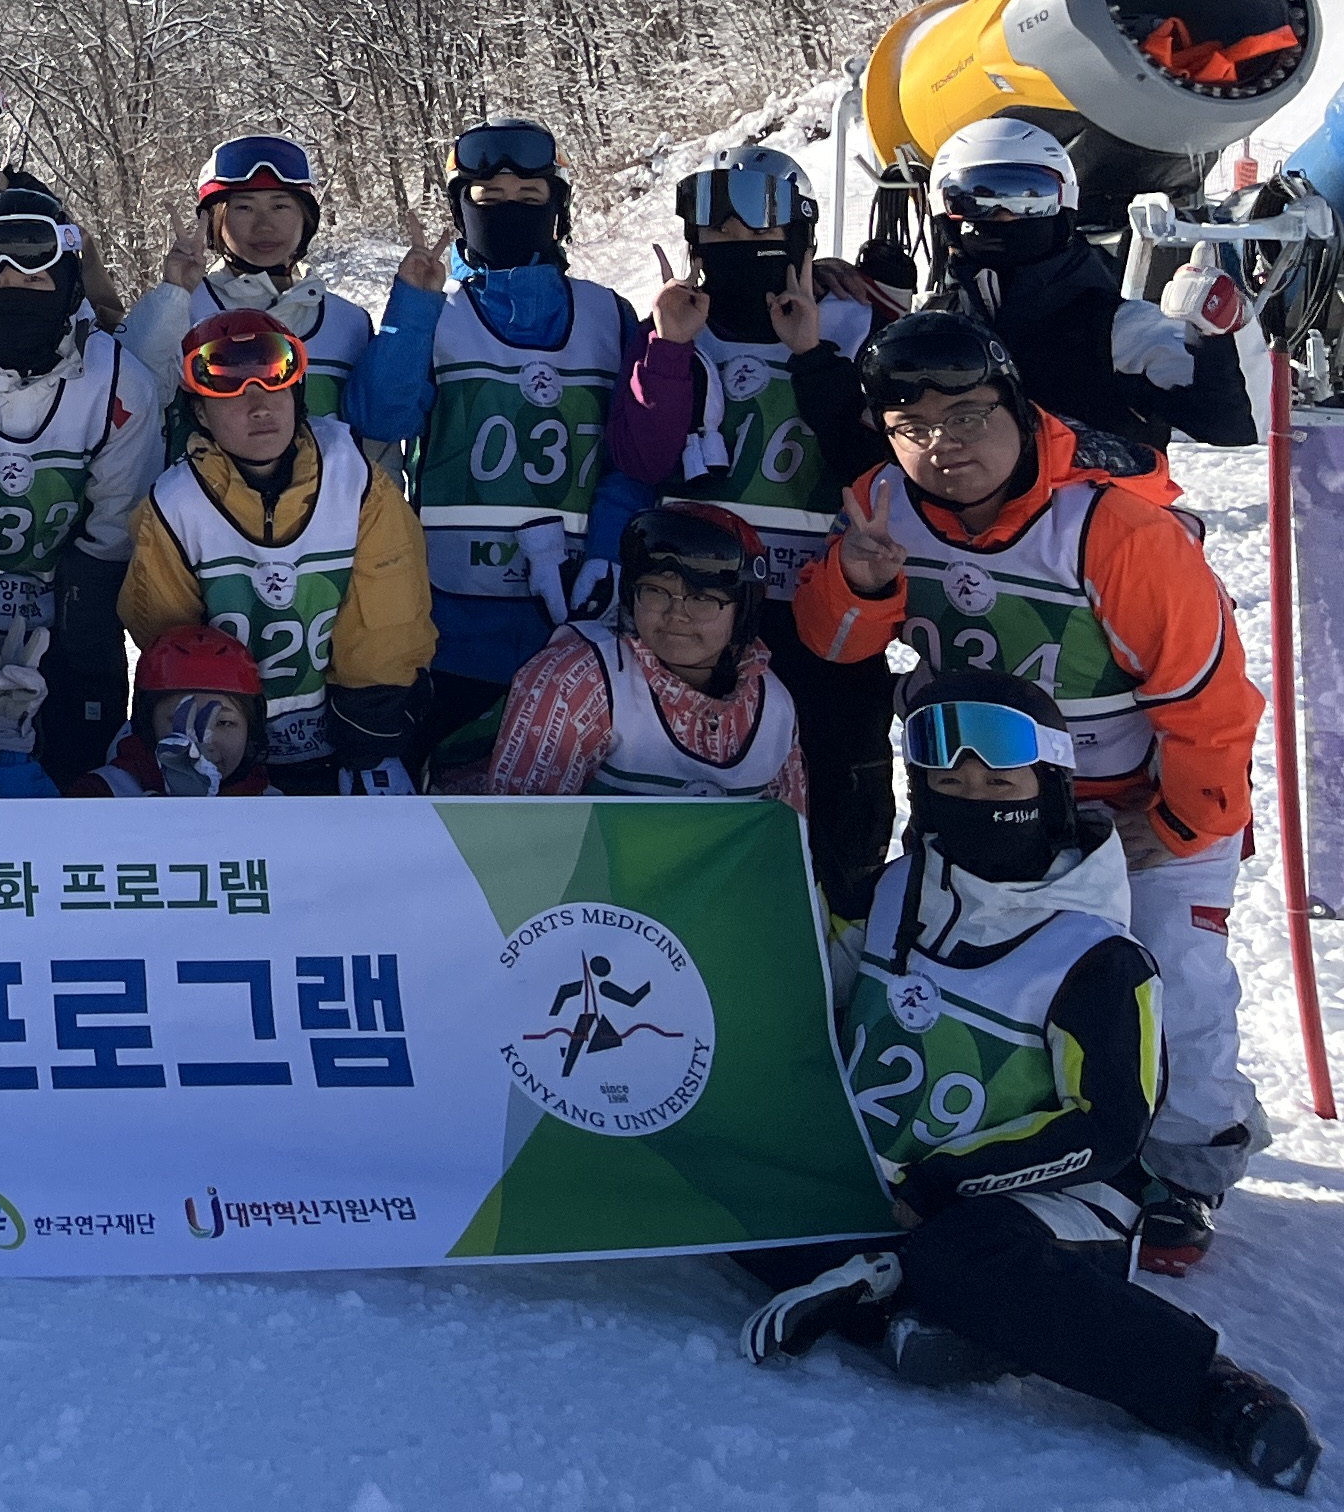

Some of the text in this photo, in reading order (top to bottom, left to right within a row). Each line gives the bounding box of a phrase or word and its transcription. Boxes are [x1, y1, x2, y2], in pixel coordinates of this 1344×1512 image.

[1017, 10, 1049, 33] TE10
[470, 414, 604, 488] 037
[726, 412, 814, 481] 16
[60, 858, 271, 915] 프로그램
[500, 908, 687, 972] SPORTS MEDICINE
[500, 1037, 710, 1131] KONYANG UNIVERSITY
[600, 1081, 630, 1094] since
[958, 1150, 1092, 1197] glennski
[33, 1210, 157, 1238] 한국연구재단
[223, 1194, 417, 1231] 대학혁신지원사업
